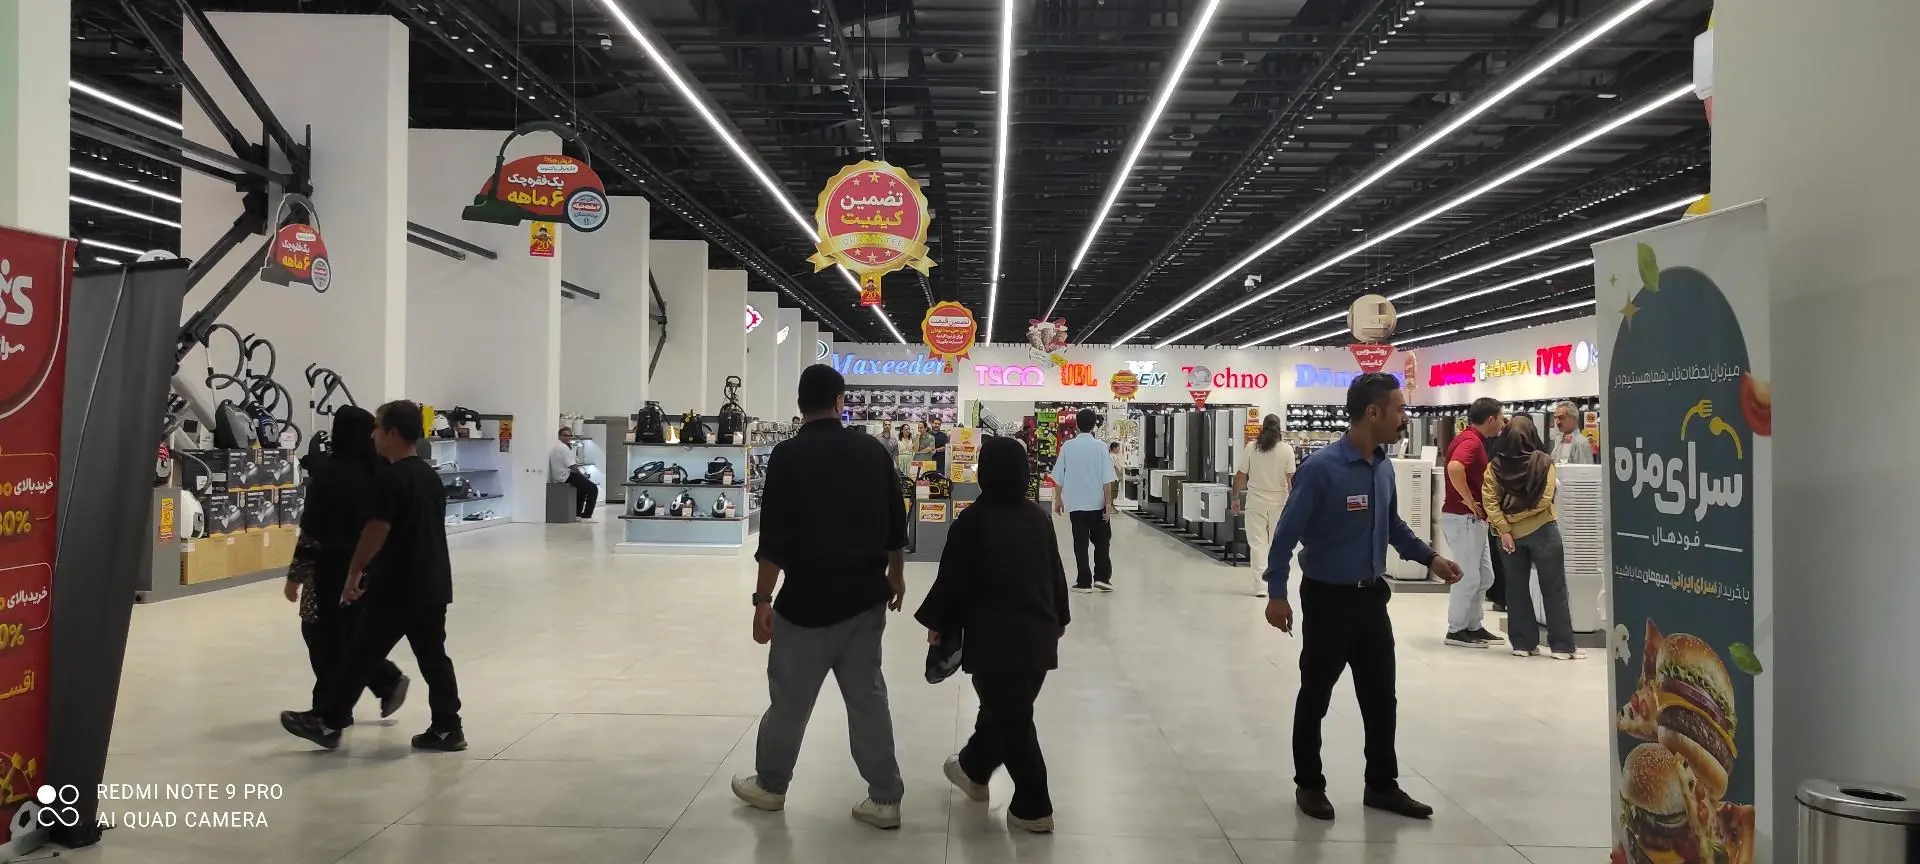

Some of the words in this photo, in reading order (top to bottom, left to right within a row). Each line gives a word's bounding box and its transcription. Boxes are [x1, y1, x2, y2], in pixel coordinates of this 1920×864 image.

[507, 173, 527, 187] چک
[528, 174, 547, 187] فقره
[507, 189, 548, 206] ماهه
[840, 190, 903, 210] تضمین
[841, 210, 904, 229] کیفیت
[831, 353, 946, 377] Maxeeder
[1680, 363, 1711, 381] لحظات
[1710, 363, 1740, 382] میزبان
[1061, 363, 1098, 386] JBL
[1182, 366, 1268, 388] Tchno
[1622, 371, 1651, 388] هستیم
[1650, 368, 1666, 382] شما
[1666, 366, 1680, 386] ناب
[1614, 437, 1663, 499] مزه
[14, 478, 35, 496] بالای
[35, 477, 54, 494] خرید
[1654, 441, 1743, 522] سرای
[1651, 526, 1700, 550] فودهال
[1615, 565, 1634, 580] باشید
[1642, 568, 1669, 588] میهمان
[28, 586, 48, 604] خرید
[1694, 577, 1717, 595] سرای
[1723, 584, 1742, 601] خرید
[7, 590, 28, 609] بالای
